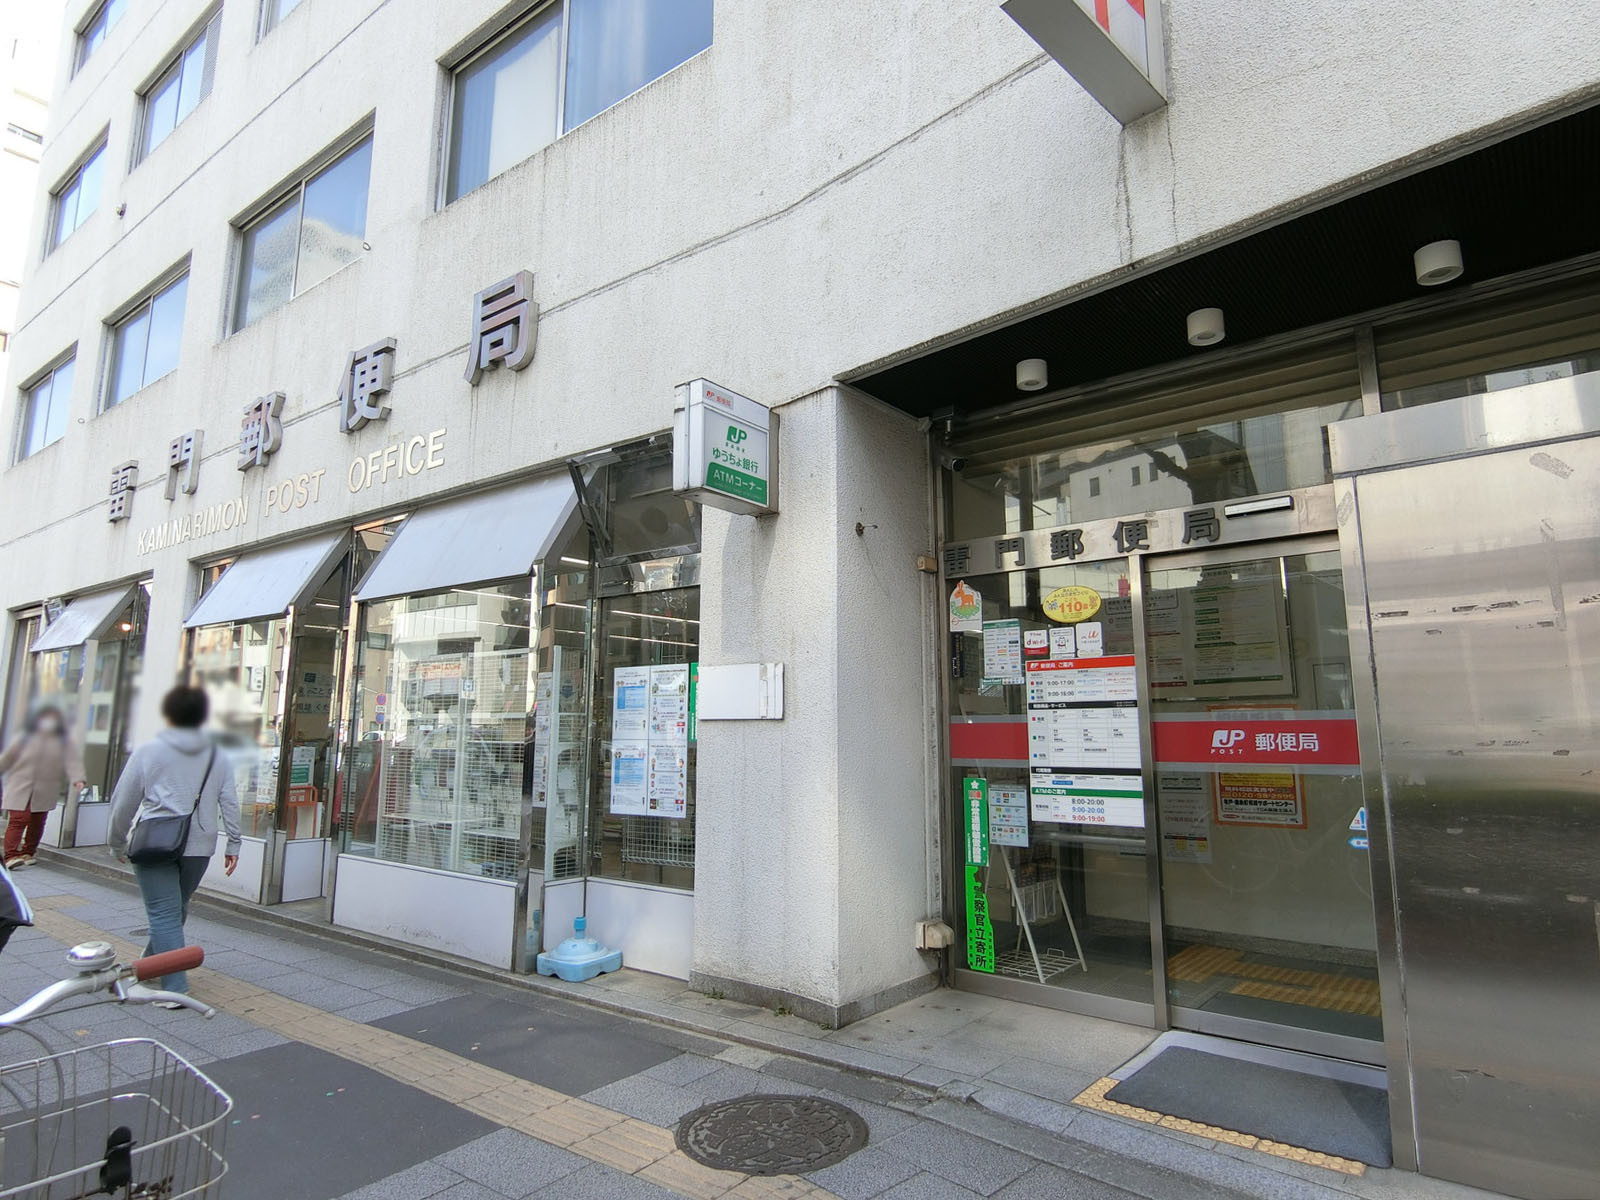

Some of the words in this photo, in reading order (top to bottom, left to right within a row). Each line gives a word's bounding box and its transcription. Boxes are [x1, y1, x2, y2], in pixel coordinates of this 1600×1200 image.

[108, 268, 540, 524] 雷門郵便局
[712, 447, 759, 474] ゆうちょ銀行
[137, 498, 249, 556] KAMINARIMON
[264, 468, 326, 517] POST
[348, 427, 448, 494] OFFICE
[713, 469, 763, 492] ATMコーナー
[943, 506, 1221, 576] 雷門郵便局
[1255, 733, 1319, 752] 郵便局
[1034, 787, 1067, 796] ATMのご案内
[1071, 798, 1105, 806] 8:00-20:00
[1071, 806, 1105, 814] 9:00-20:00
[1071, 814, 1105, 822] 9:00-19:00
[973, 886, 987, 969] 警察官立寄所
